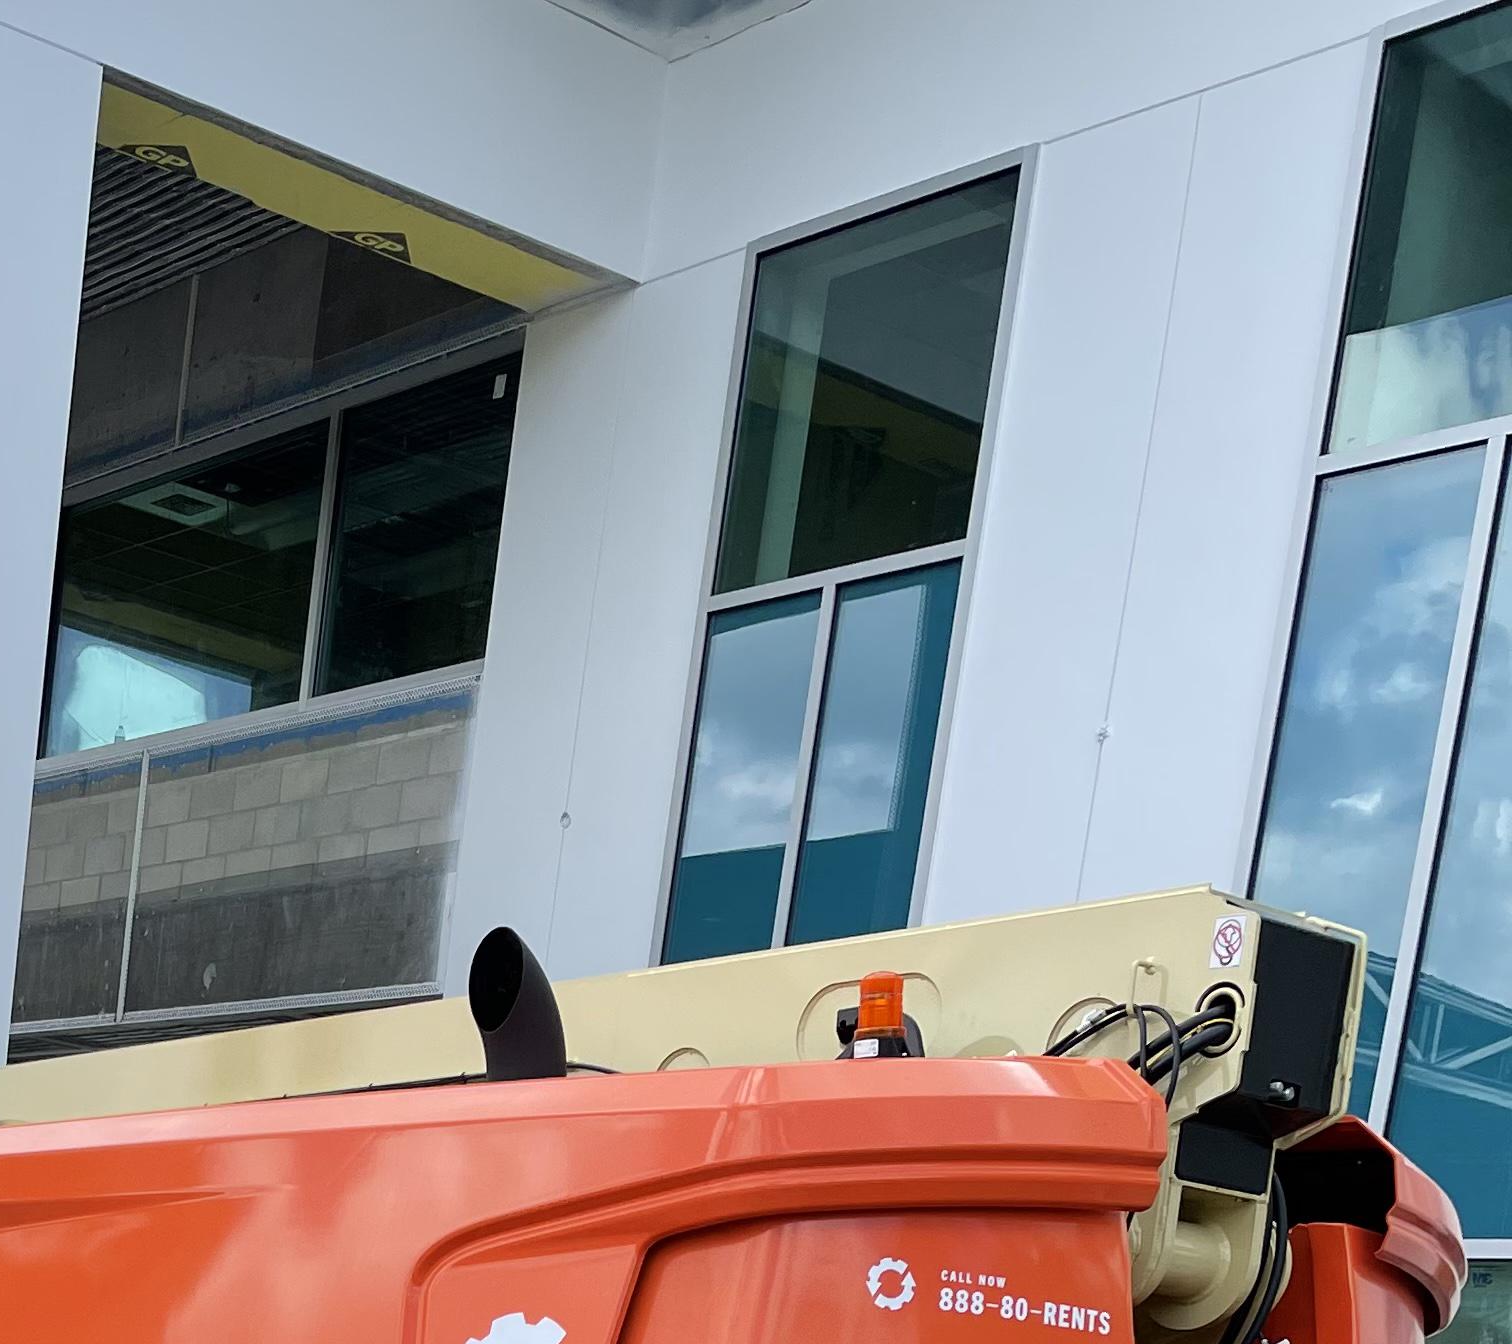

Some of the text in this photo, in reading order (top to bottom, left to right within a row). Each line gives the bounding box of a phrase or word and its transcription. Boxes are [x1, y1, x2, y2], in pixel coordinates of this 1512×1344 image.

[135, 146, 189, 167] GP
[354, 232, 405, 252] GP
[941, 1269, 1006, 1288] CALL NOW
[939, 1287, 1111, 1335] 888-80-RENTS
